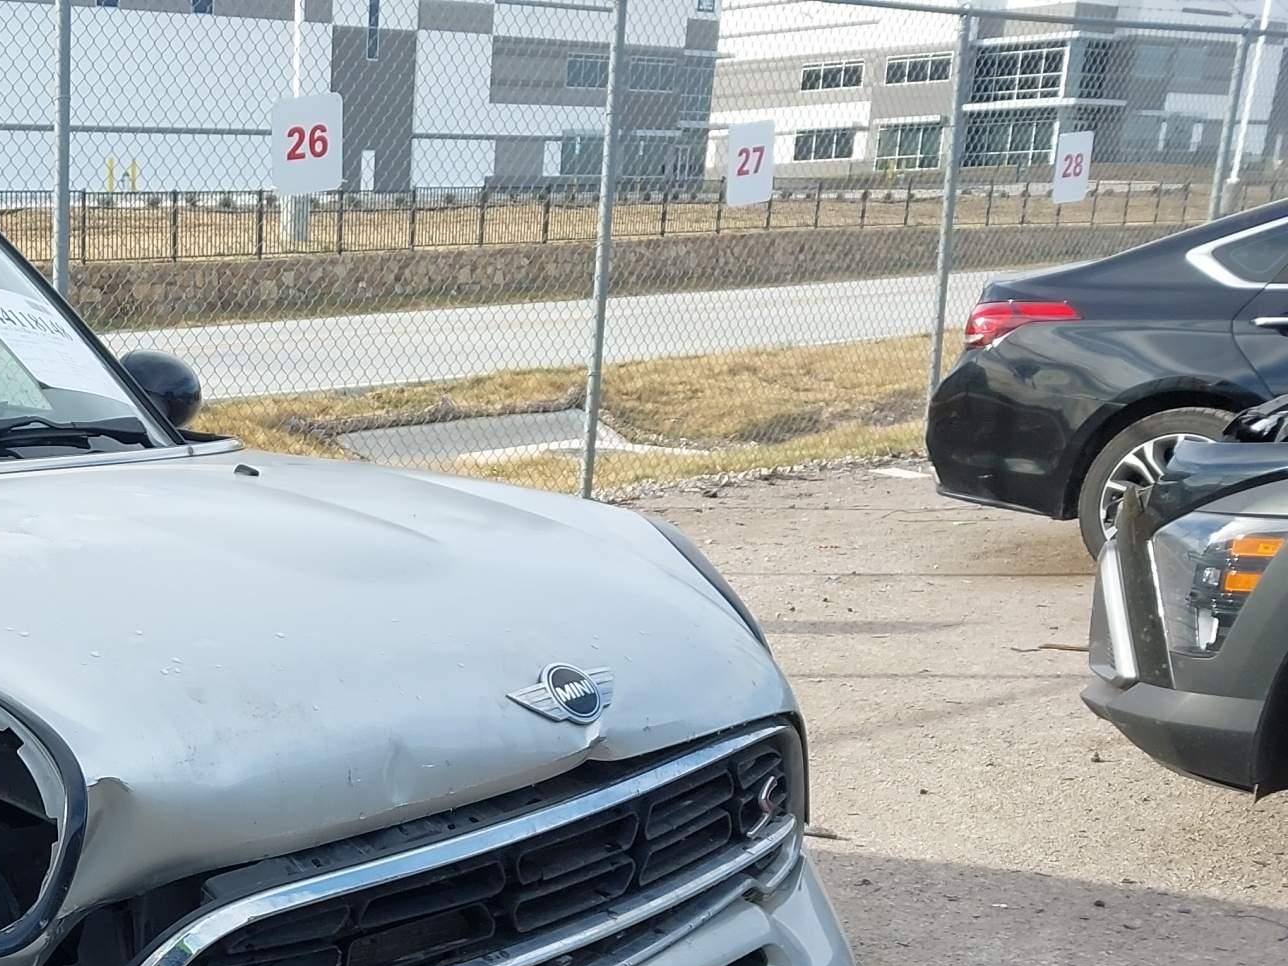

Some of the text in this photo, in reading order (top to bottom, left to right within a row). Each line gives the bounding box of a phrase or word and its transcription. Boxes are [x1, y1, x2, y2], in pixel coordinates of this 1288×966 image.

[286, 124, 329, 161] 26
[737, 145, 765, 176] 27
[1062, 152, 1083, 178] 28
[555, 679, 595, 702] MINI
